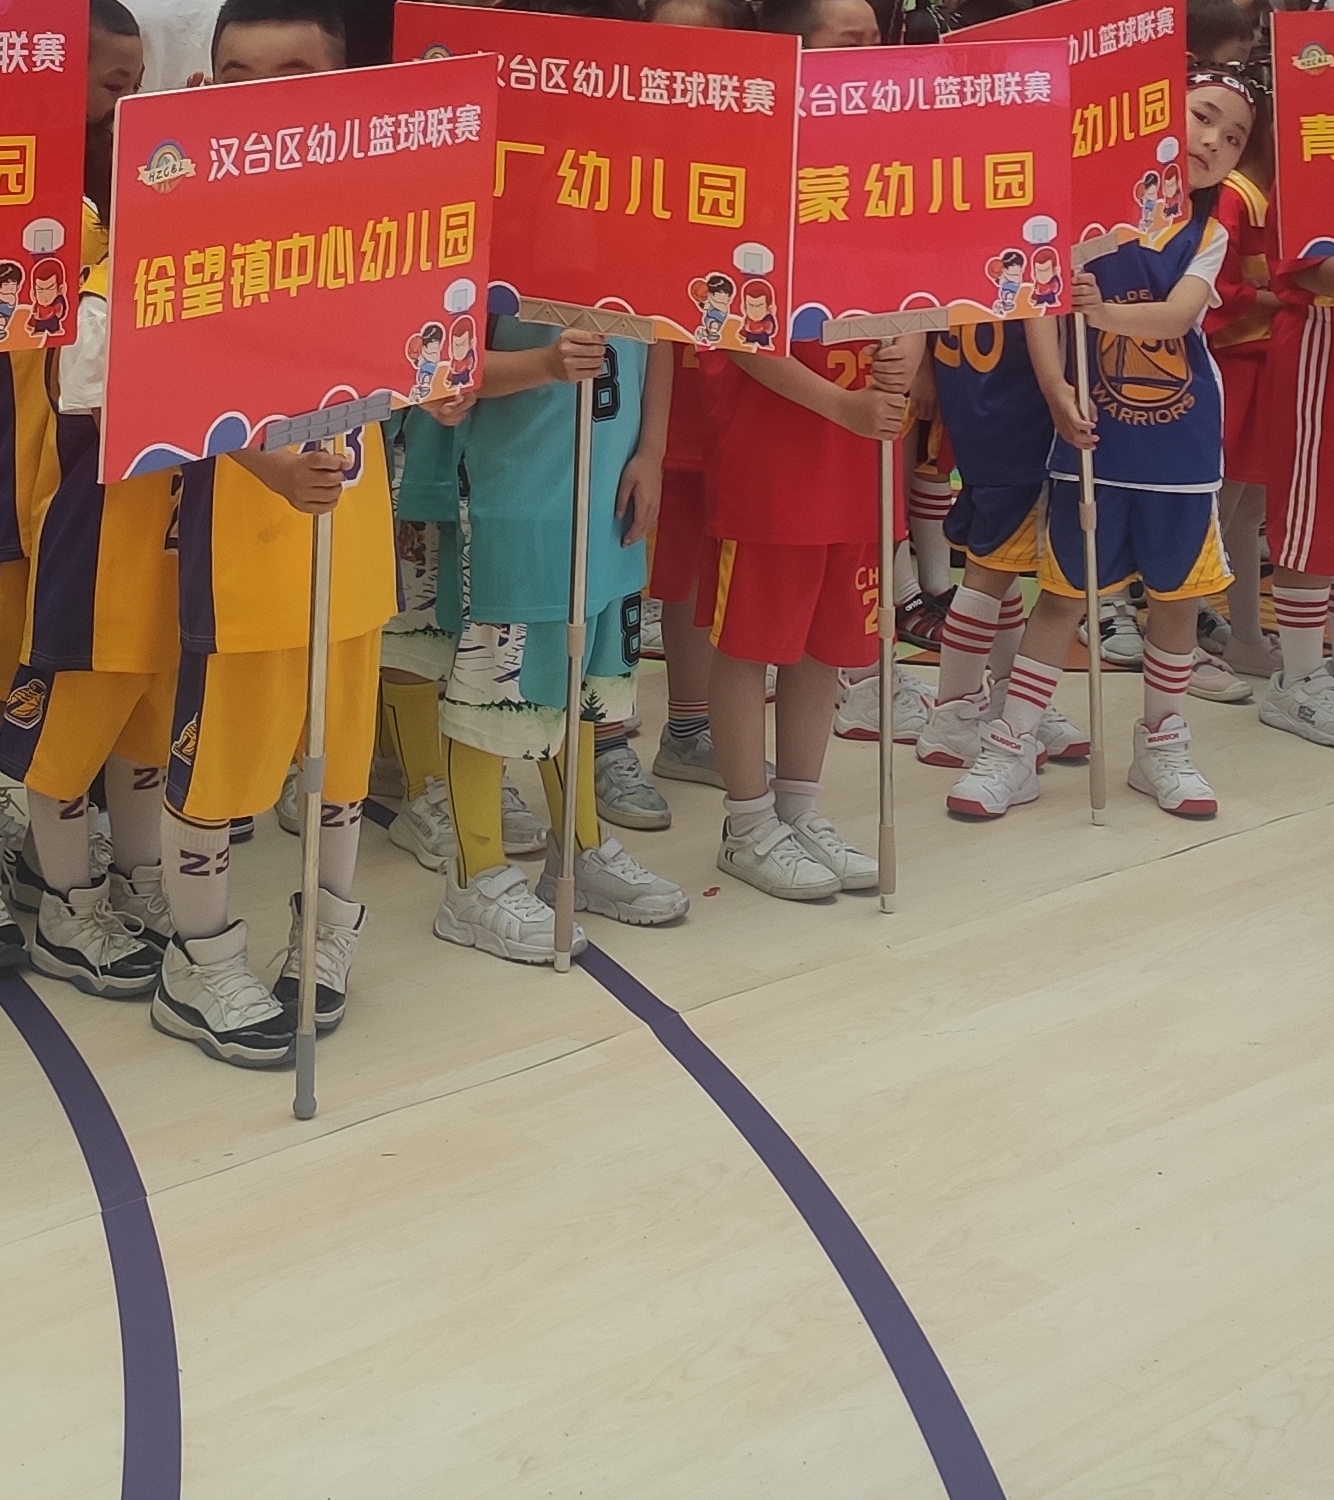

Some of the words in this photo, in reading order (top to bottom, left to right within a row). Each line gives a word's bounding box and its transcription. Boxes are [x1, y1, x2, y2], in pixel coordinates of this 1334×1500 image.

[207, 103, 482, 182] 汉台区幼儿篮球联赛
[1070, 79, 1171, 159] 幼儿园
[133, 201, 477, 330] 徐望镇中心幼儿园
[1090, 382, 1196, 427] WARRIORS
